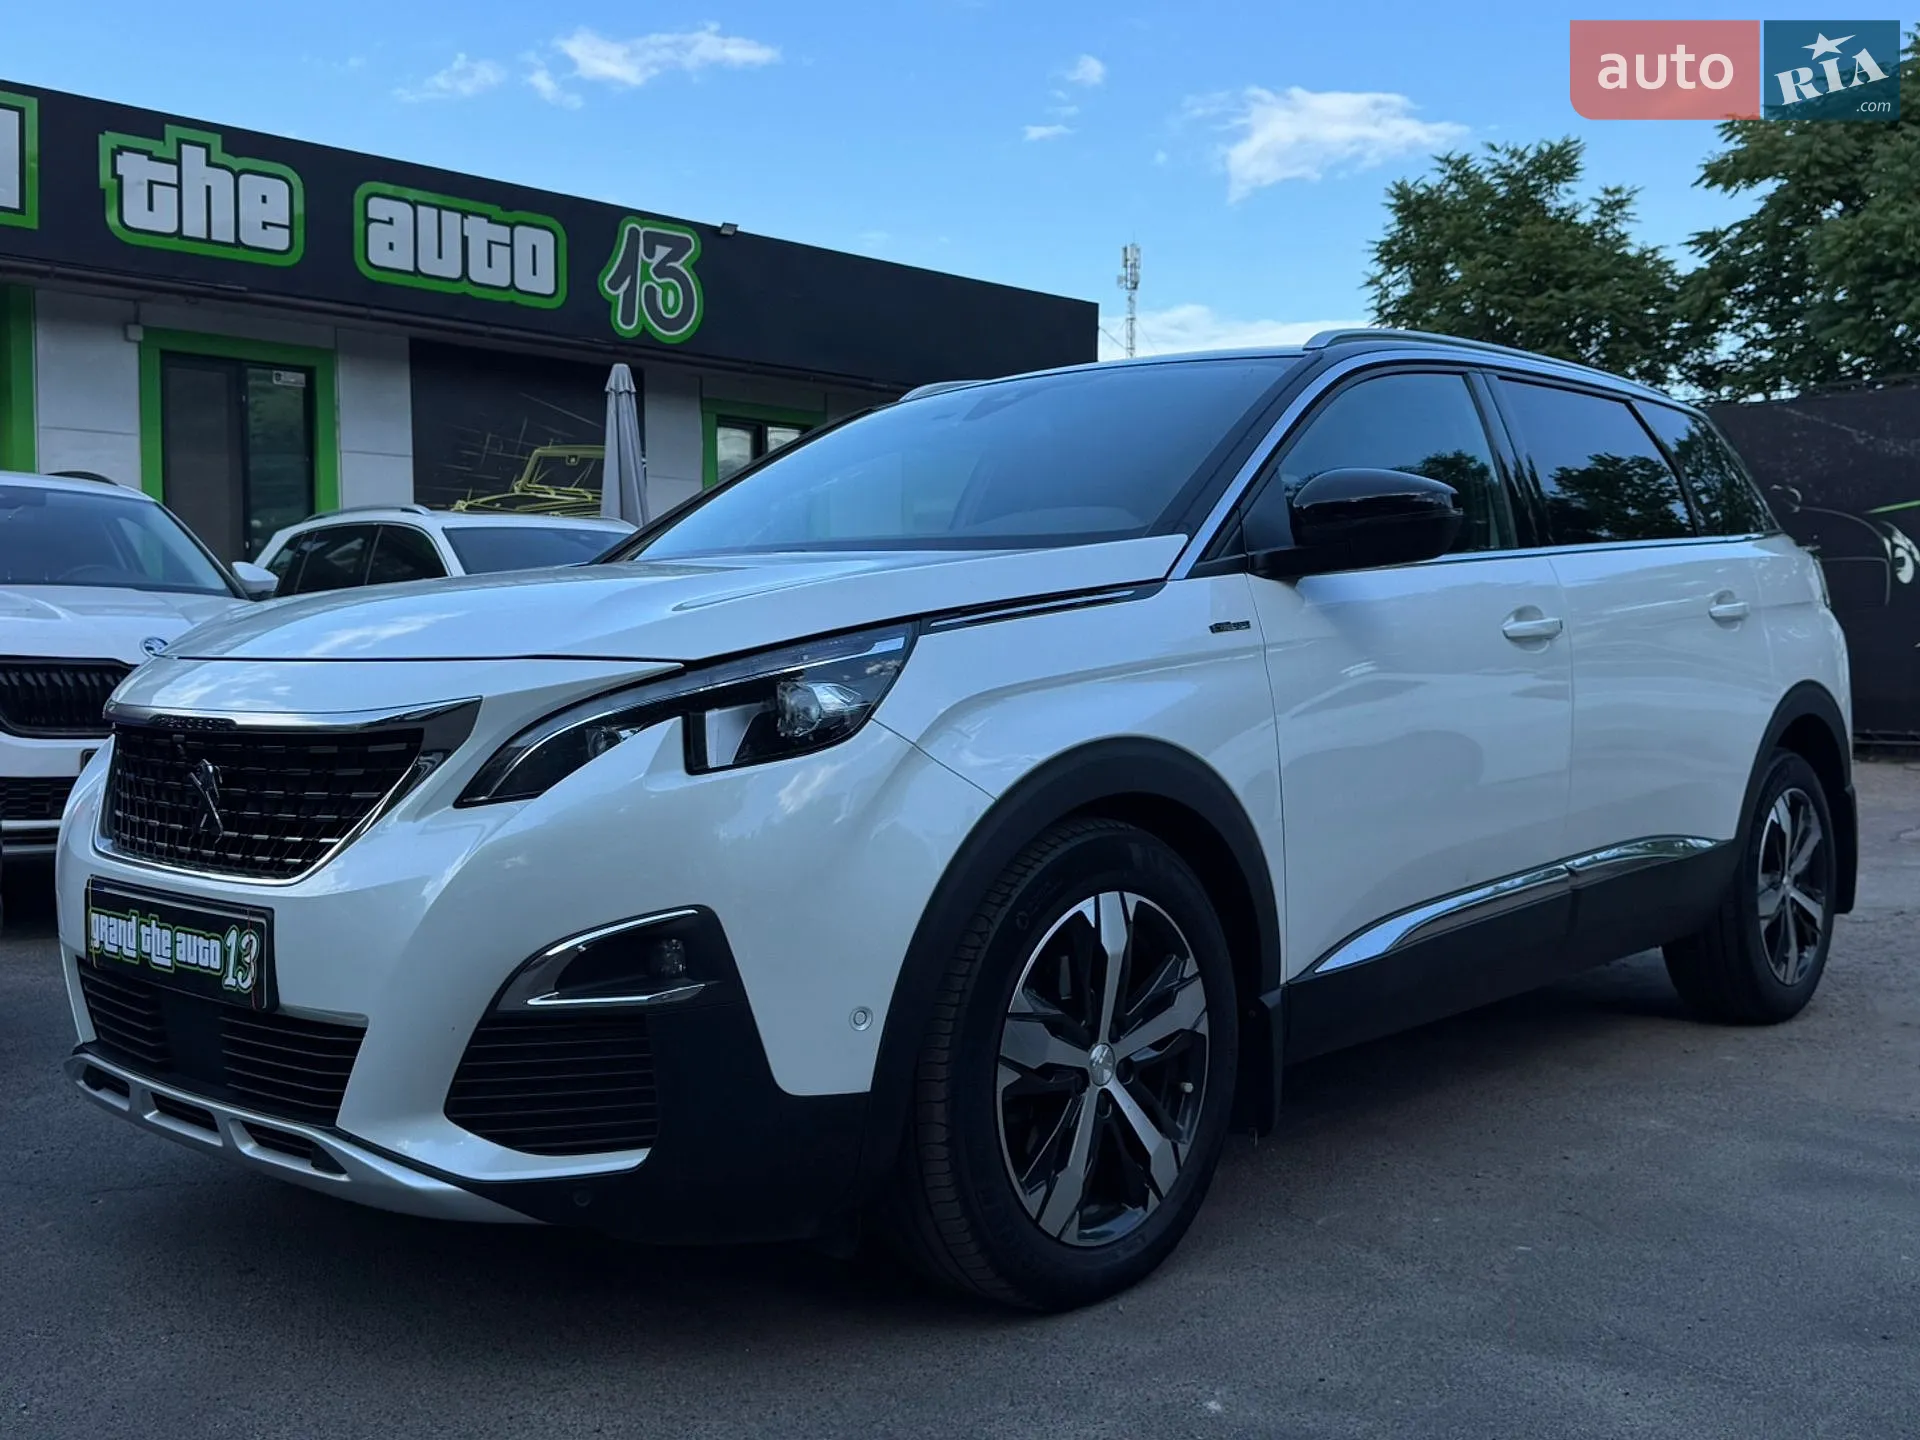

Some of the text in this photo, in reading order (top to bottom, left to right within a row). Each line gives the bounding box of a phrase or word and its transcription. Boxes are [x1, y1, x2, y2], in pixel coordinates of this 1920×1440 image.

[116, 143, 290, 251] the
[367, 196, 556, 295] auto
[604, 223, 698, 336] 13
[90, 912, 258, 990] grand the auto 13
